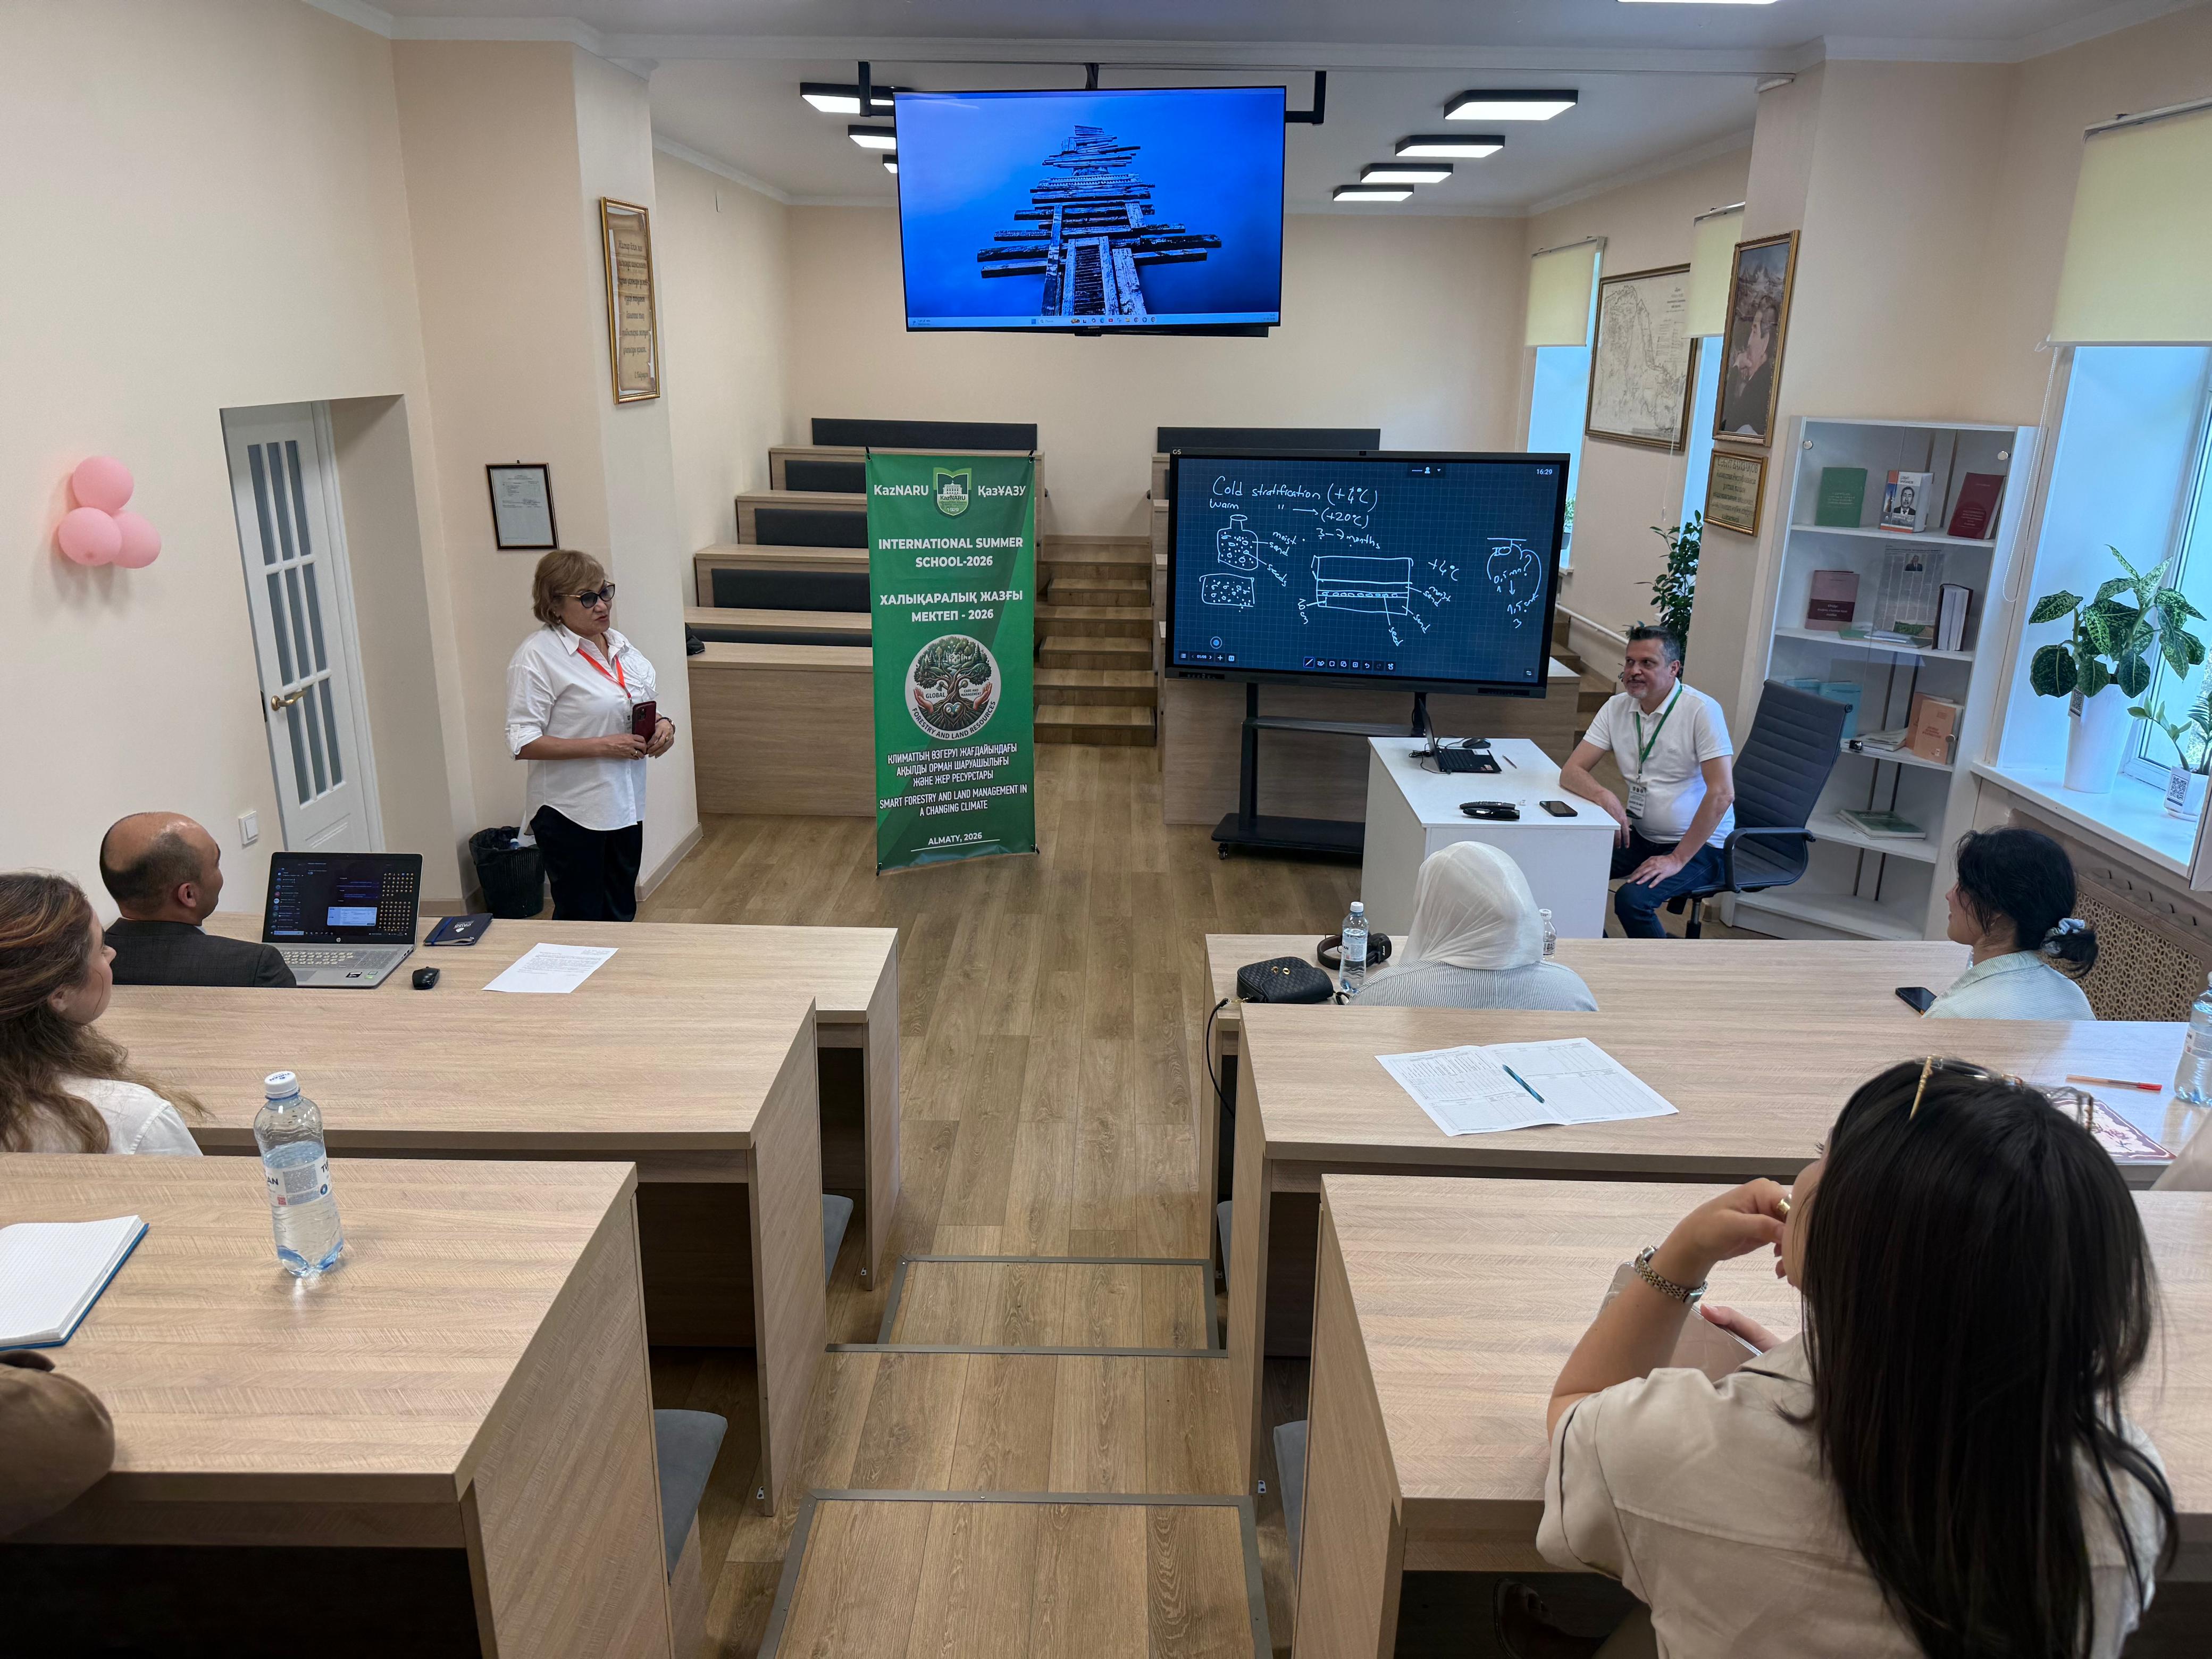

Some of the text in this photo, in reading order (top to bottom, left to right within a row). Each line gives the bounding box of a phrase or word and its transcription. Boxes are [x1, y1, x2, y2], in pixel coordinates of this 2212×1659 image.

[874, 485, 929, 496] KazNARU
[977, 485, 1026, 498] ҚазҰАЗУ
[1213, 475, 1243, 496] Cold
[878, 537, 1023, 549] INTERNATIONAL SUMMER
[1272, 532, 1297, 545] moist
[1269, 541, 1290, 557] sand
[915, 556, 993, 567] SCHOOL-2026
[1267, 564, 1288, 587] seeds
[880, 590, 1023, 606] ХАЛЫҚАРАЛЫҚ ЖАЗҒЫ
[911, 611, 959, 622] МЕКТЕП
[968, 609, 994, 619] 2026
[1413, 614, 1431, 634] sand
[1388, 626, 1404, 647] seed
[912, 707, 936, 734] FORESTRY
[951, 730, 969, 739] LAND
[970, 701, 996, 733] RESOURCES
[887, 751, 930, 765] КЛИМАТТЫҢ
[896, 756, 1009, 777] АҚЫЛДЫ ОРМАН ШАРУАШЫЛЫҒЫ
[913, 770, 993, 787] ЖӘНЕ ЖЕР РЕСУРСТАРЫ
[879, 784, 1027, 809] SMART FORESTRY AND LAND MANAGEMENT IN
[919, 799, 988, 817] A CHANGING CLIMATE
[928, 832, 983, 845] ALMATY, 2026
